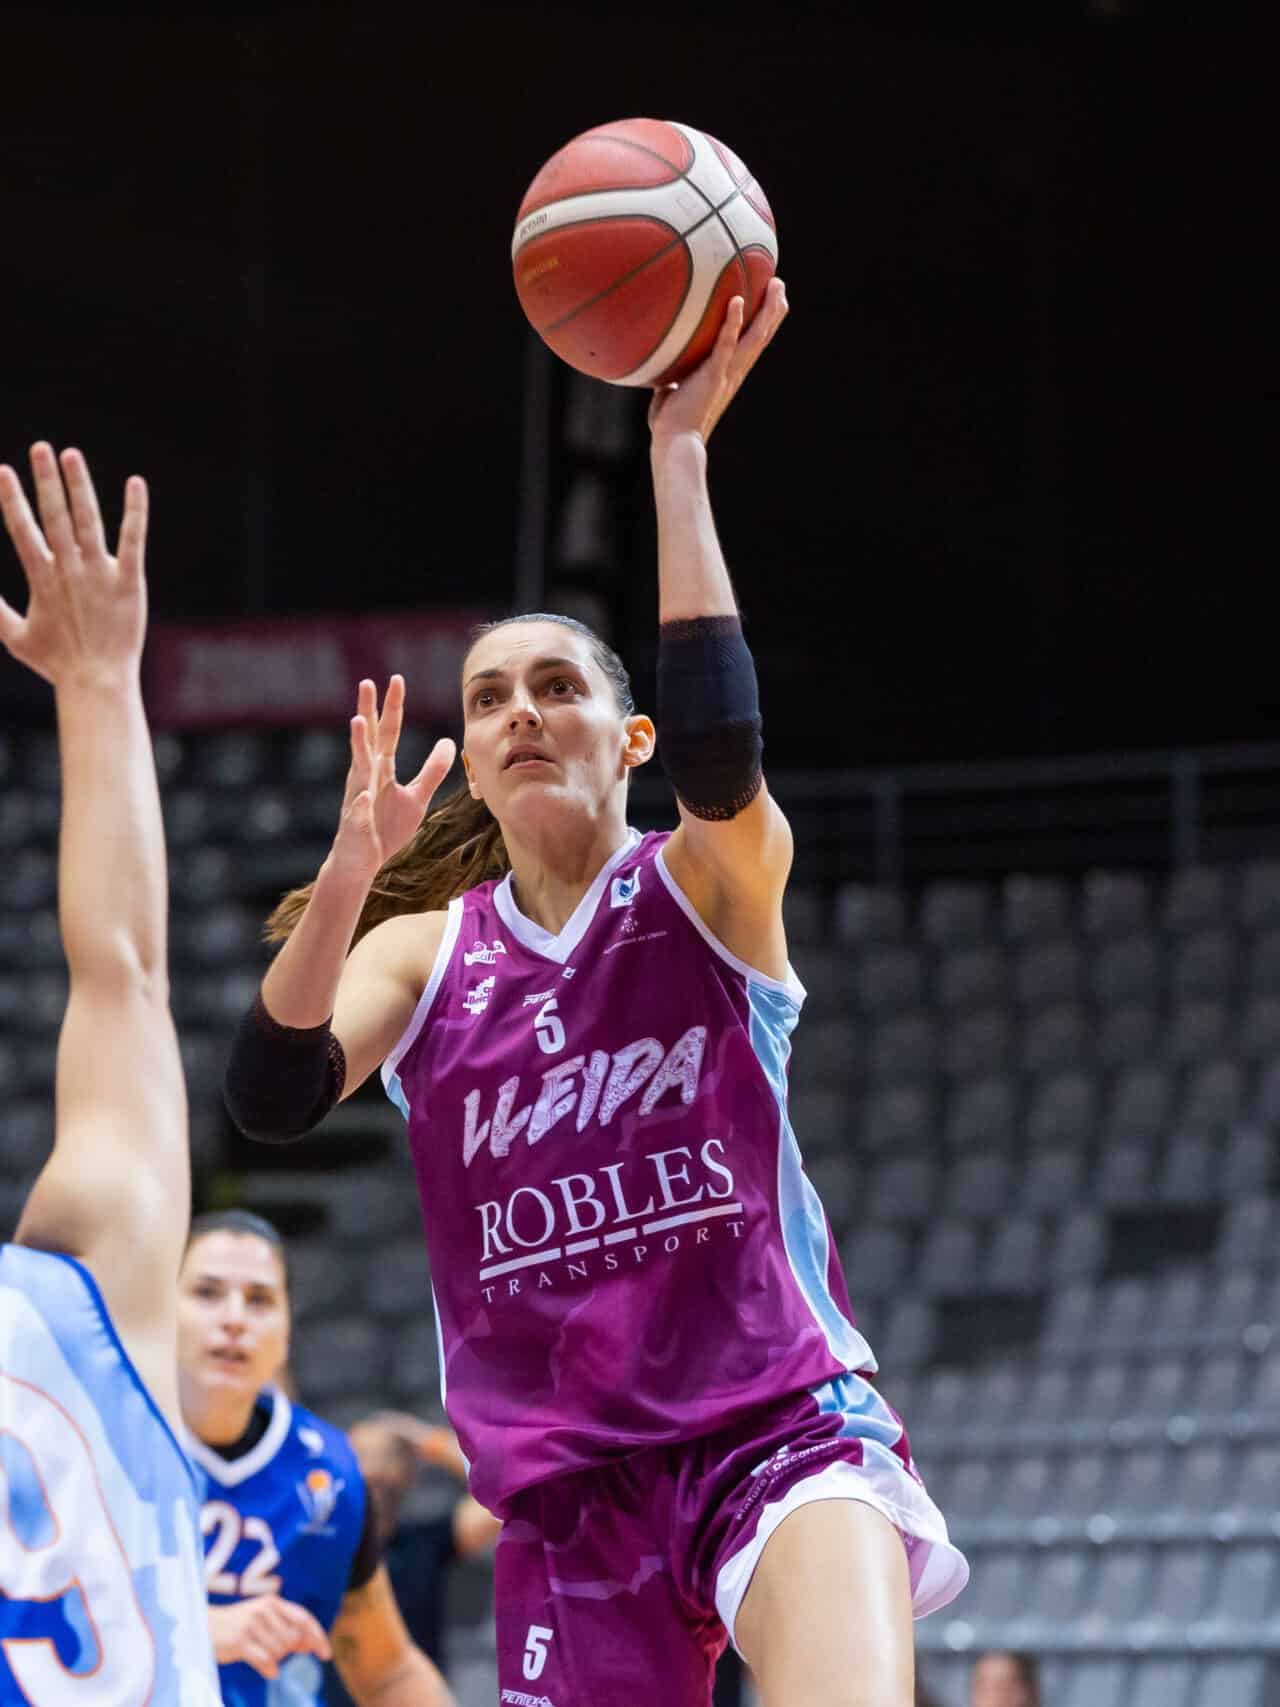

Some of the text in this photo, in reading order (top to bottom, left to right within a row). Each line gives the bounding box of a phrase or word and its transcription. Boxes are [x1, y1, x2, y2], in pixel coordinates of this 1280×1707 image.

[534, 998, 566, 1054] 5
[463, 1026, 707, 1168] LLEIDA
[474, 1139, 734, 1262] ROBLES
[481, 1221, 745, 1304] TRANSPORT
[200, 1499, 283, 1597] 22
[522, 1625, 554, 1681] 5
